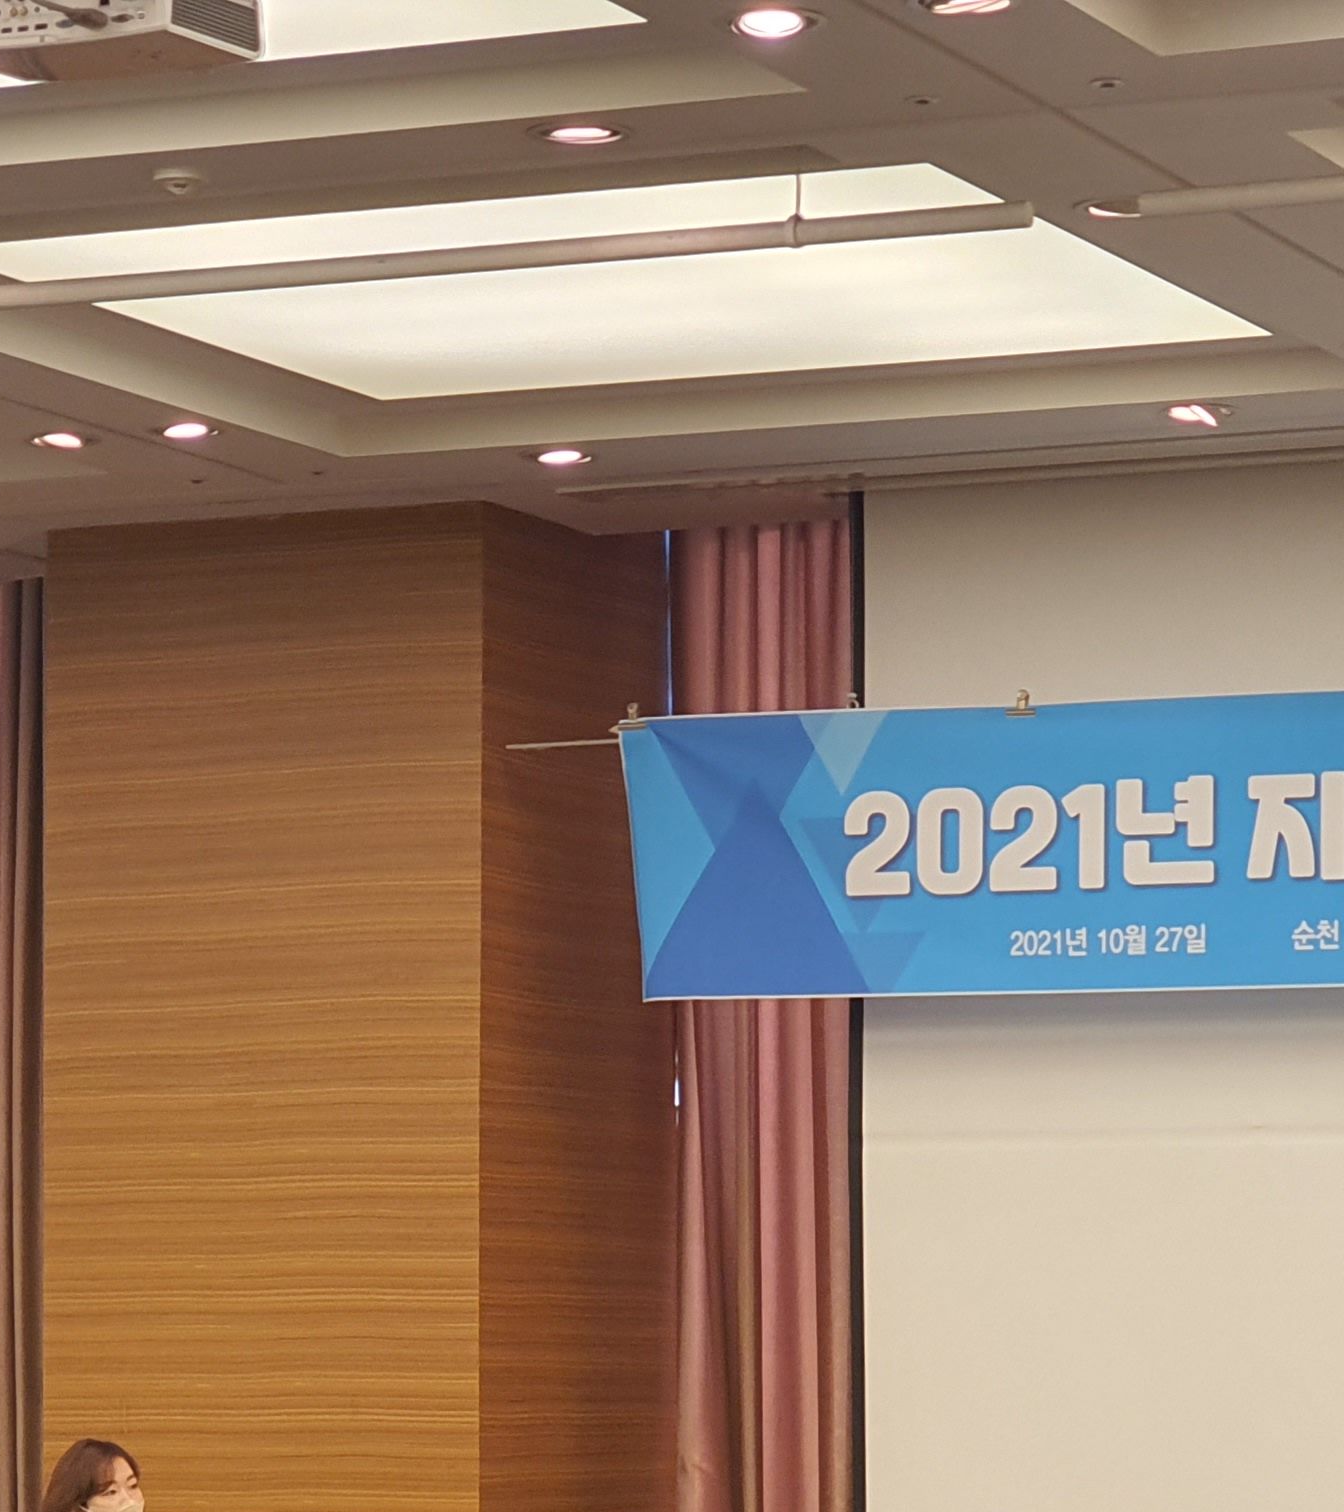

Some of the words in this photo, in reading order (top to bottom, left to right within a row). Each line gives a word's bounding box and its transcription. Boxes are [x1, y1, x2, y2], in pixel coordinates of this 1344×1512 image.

[844, 775, 1215, 897] 2021년
[1009, 926, 1088, 957] 2021년
[1097, 924, 1147, 956] 10월
[1154, 923, 1207, 955] 27일
[1291, 919, 1340, 951] 순천
